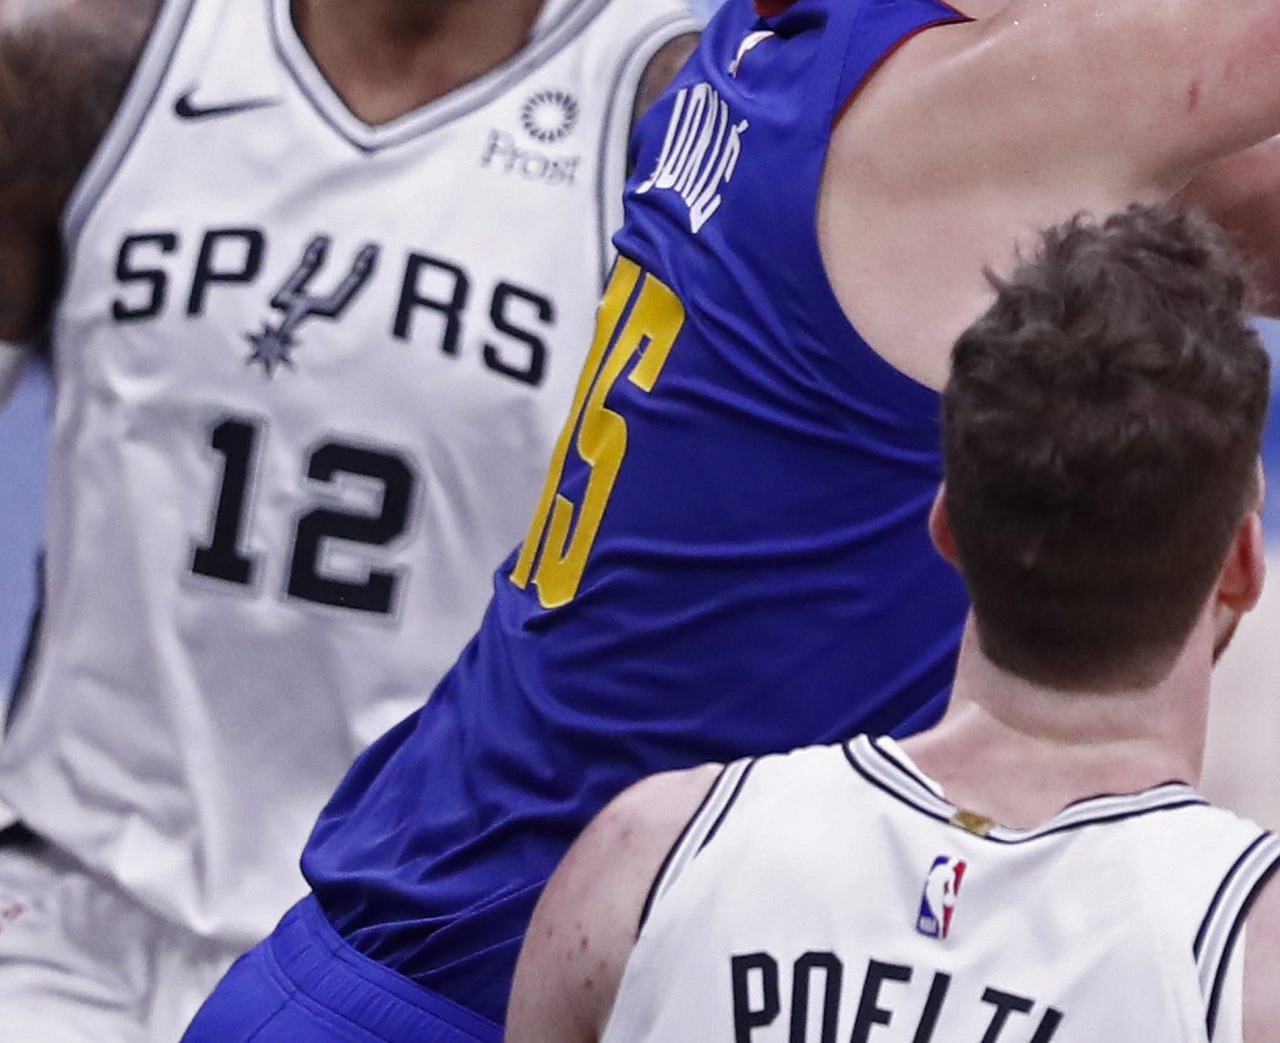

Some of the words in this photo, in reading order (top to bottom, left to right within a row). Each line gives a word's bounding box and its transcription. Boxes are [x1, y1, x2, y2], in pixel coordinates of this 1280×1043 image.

[111, 228, 556, 388] SPURS
[188, 418, 419, 616] 12
[510, 255, 686, 608] 15
[730, 951, 1064, 1043] POELT
